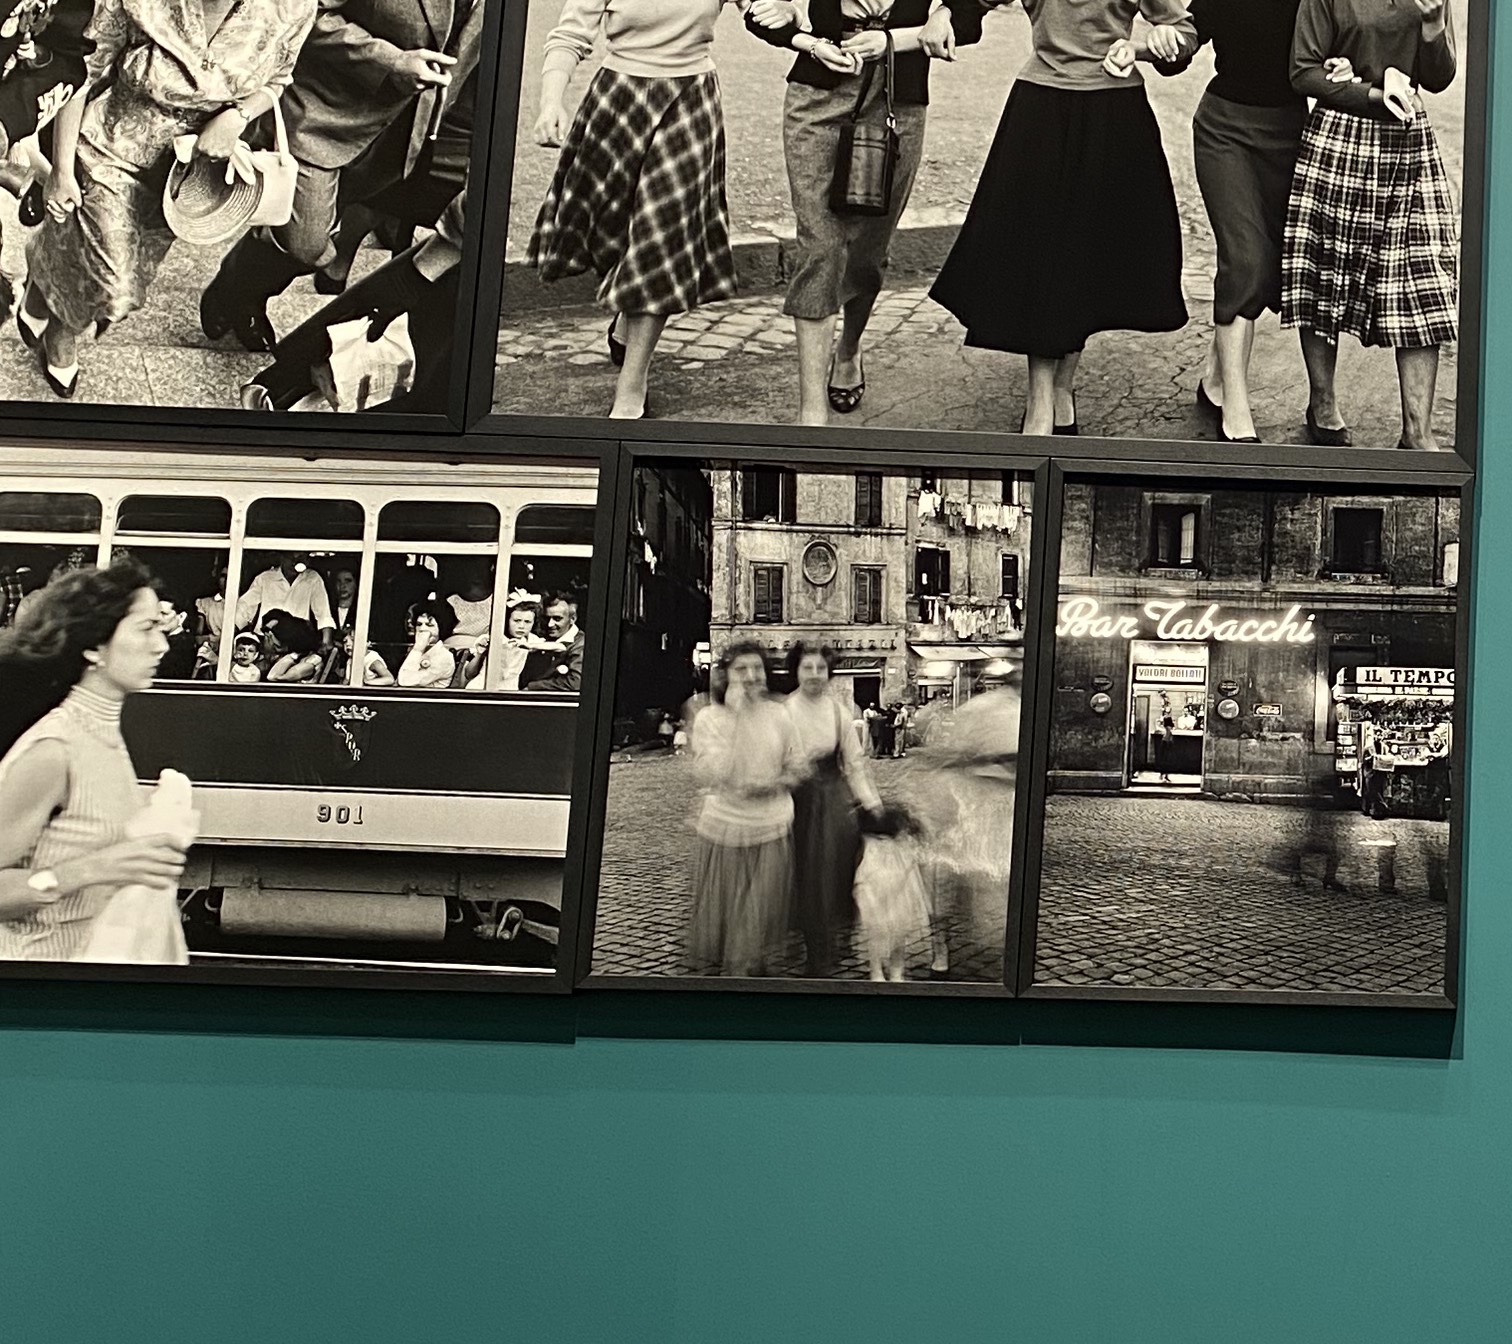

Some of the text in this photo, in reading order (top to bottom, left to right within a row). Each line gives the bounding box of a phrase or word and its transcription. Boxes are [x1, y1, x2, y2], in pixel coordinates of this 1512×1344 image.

[1056, 597, 1317, 644] Bar Tabacchi
[1364, 669, 1382, 682] IL
[316, 803, 363, 825] 901
